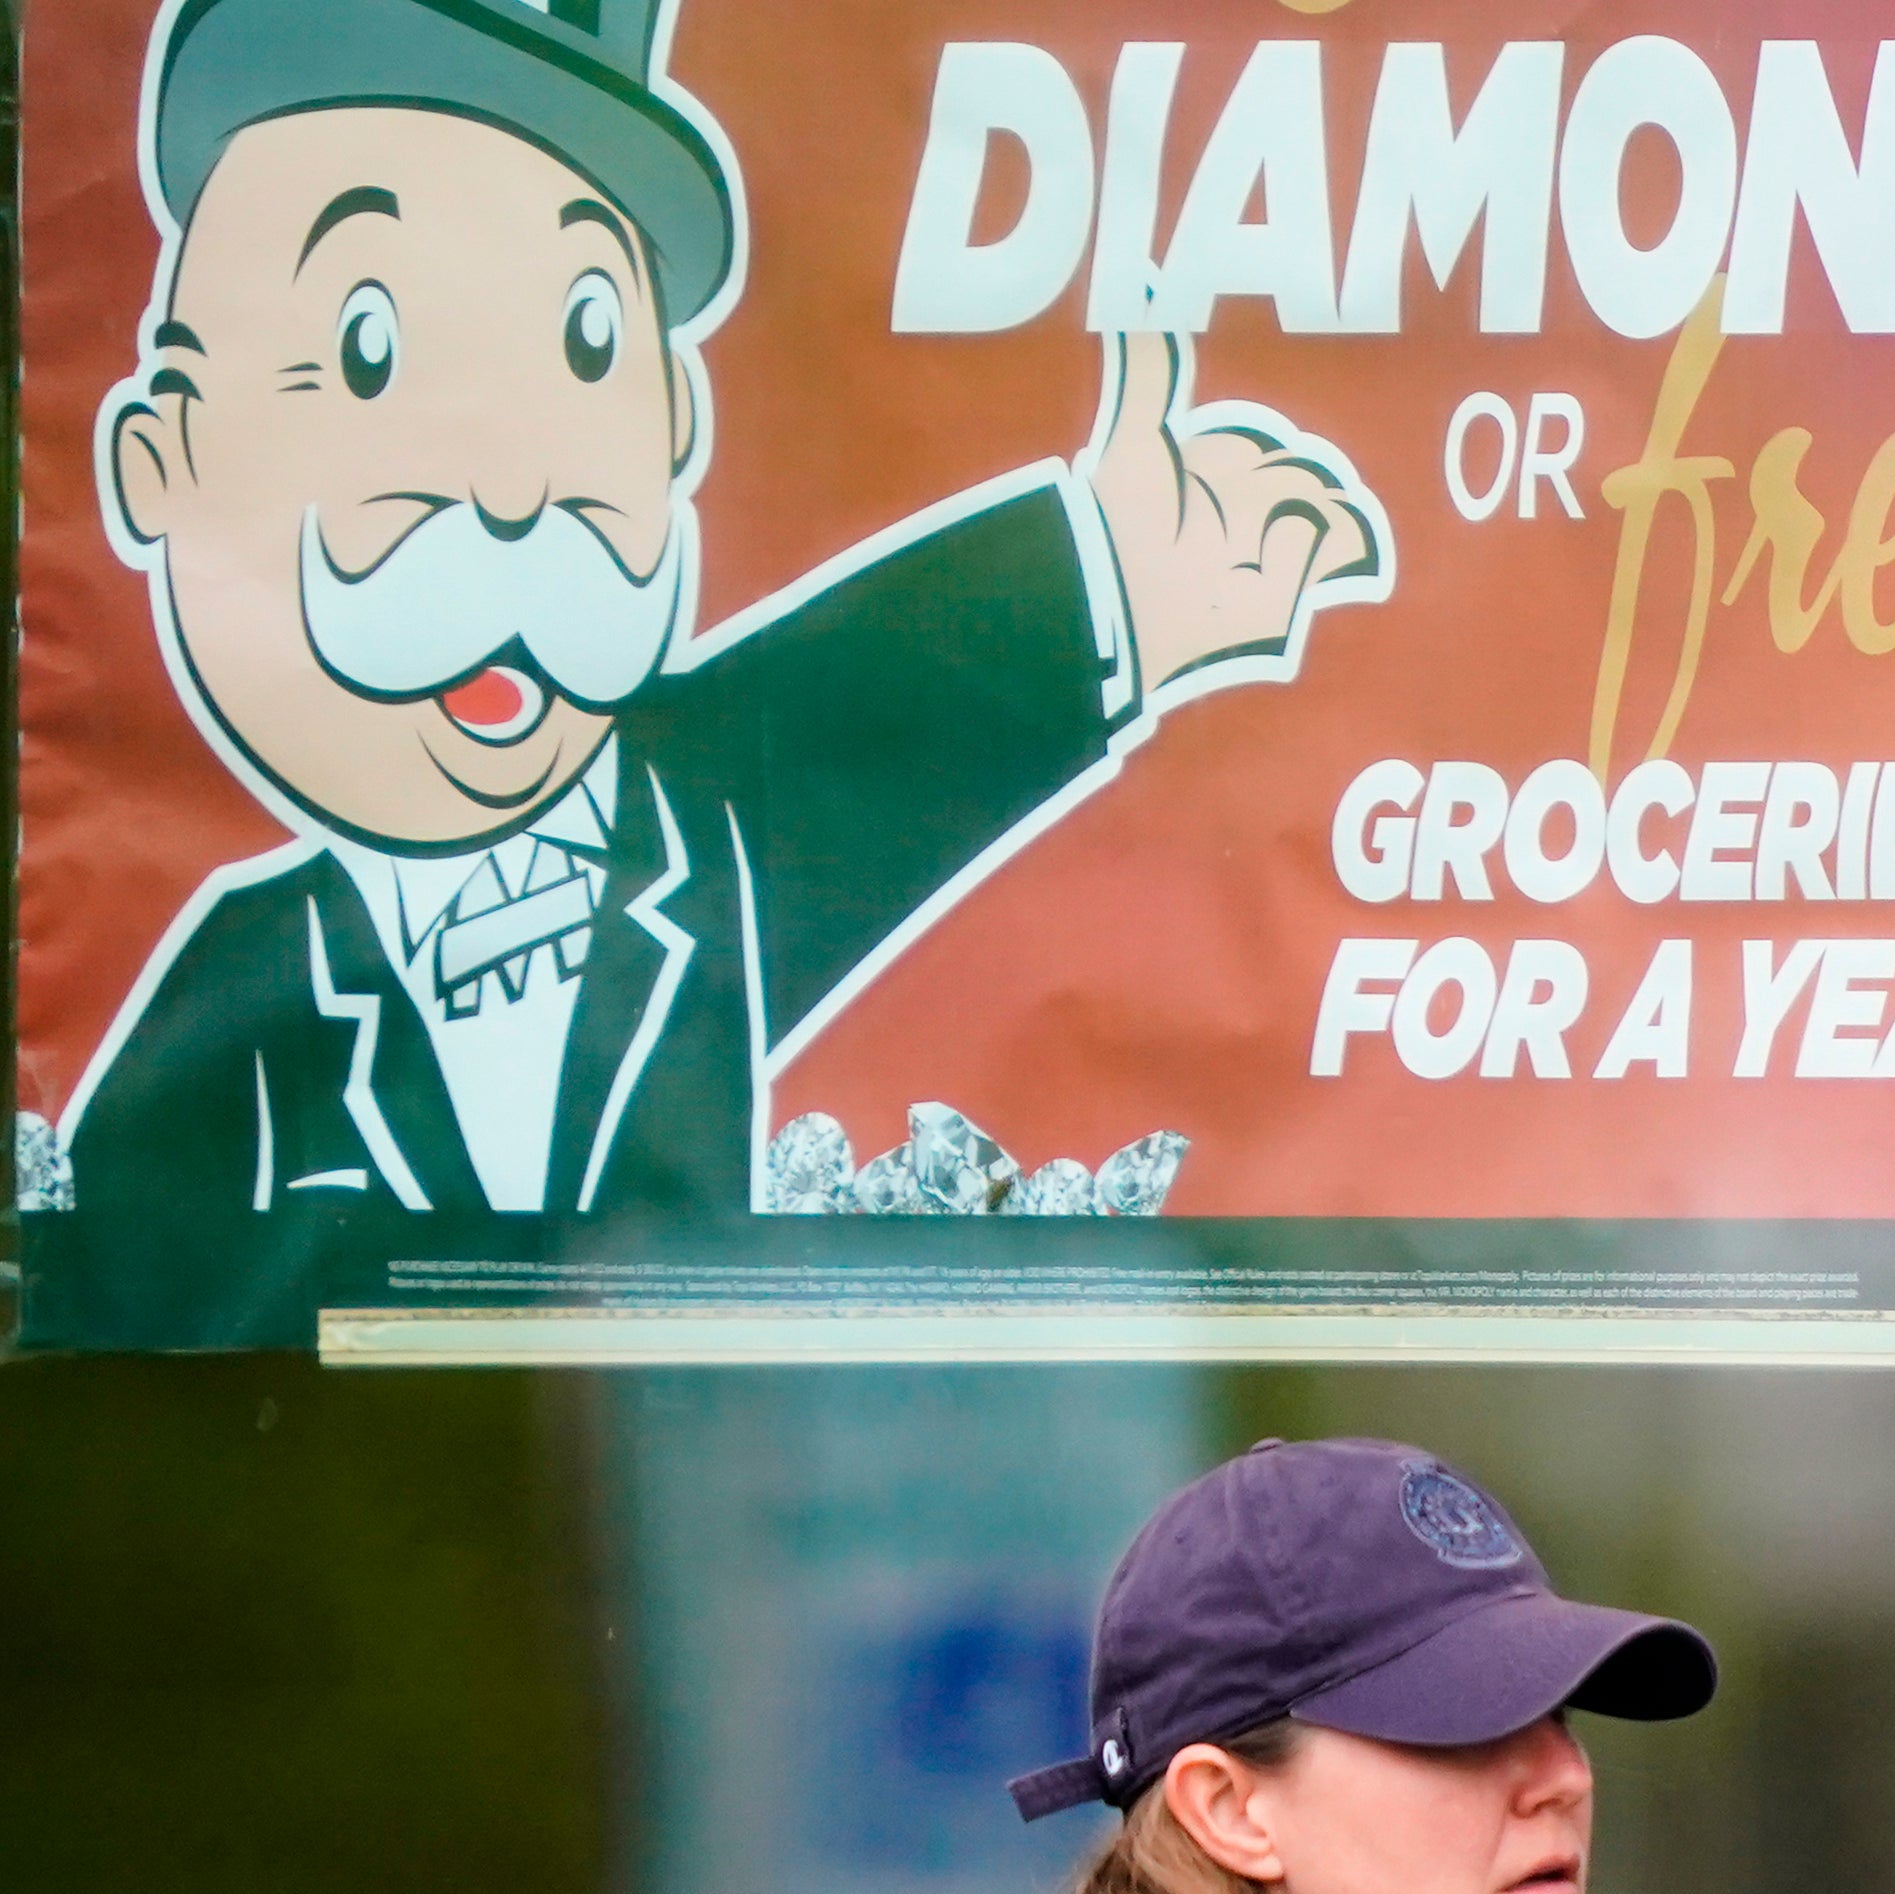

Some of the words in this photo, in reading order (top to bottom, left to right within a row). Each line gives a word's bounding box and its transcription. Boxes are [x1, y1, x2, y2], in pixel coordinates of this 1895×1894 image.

[1444, 390, 1585, 521] OR
[1309, 936, 1589, 1080] FOR
[1594, 938, 1694, 1078] A
